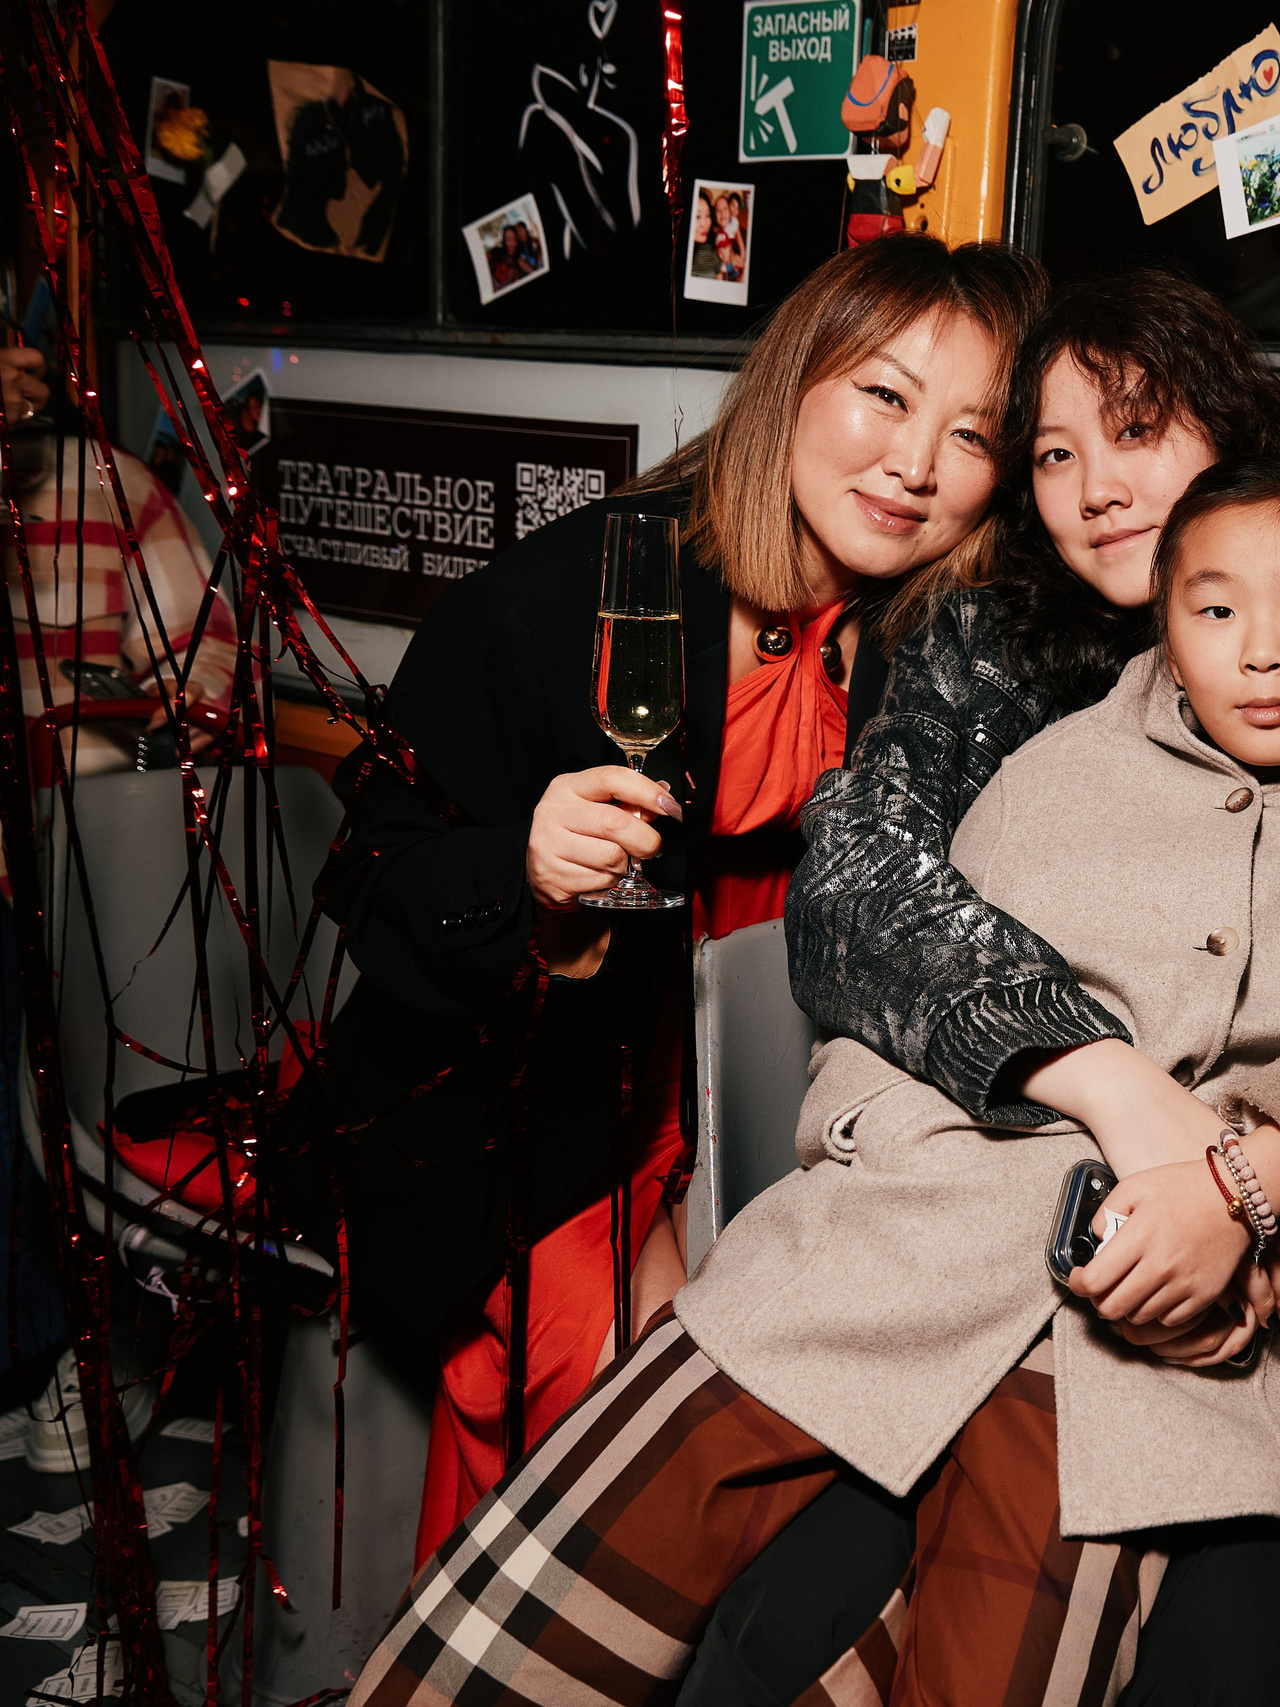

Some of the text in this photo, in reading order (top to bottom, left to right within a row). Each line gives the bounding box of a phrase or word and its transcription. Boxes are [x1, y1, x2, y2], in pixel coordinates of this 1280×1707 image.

[752, 4, 850, 37] ЗАПАСНЫЙ
[768, 36, 832, 63] ВЫХОД
[277, 458, 495, 515] ТЕАТРАЛЬНОЕ
[277, 491, 495, 550] ПУТЕШЕСТВИЕ
